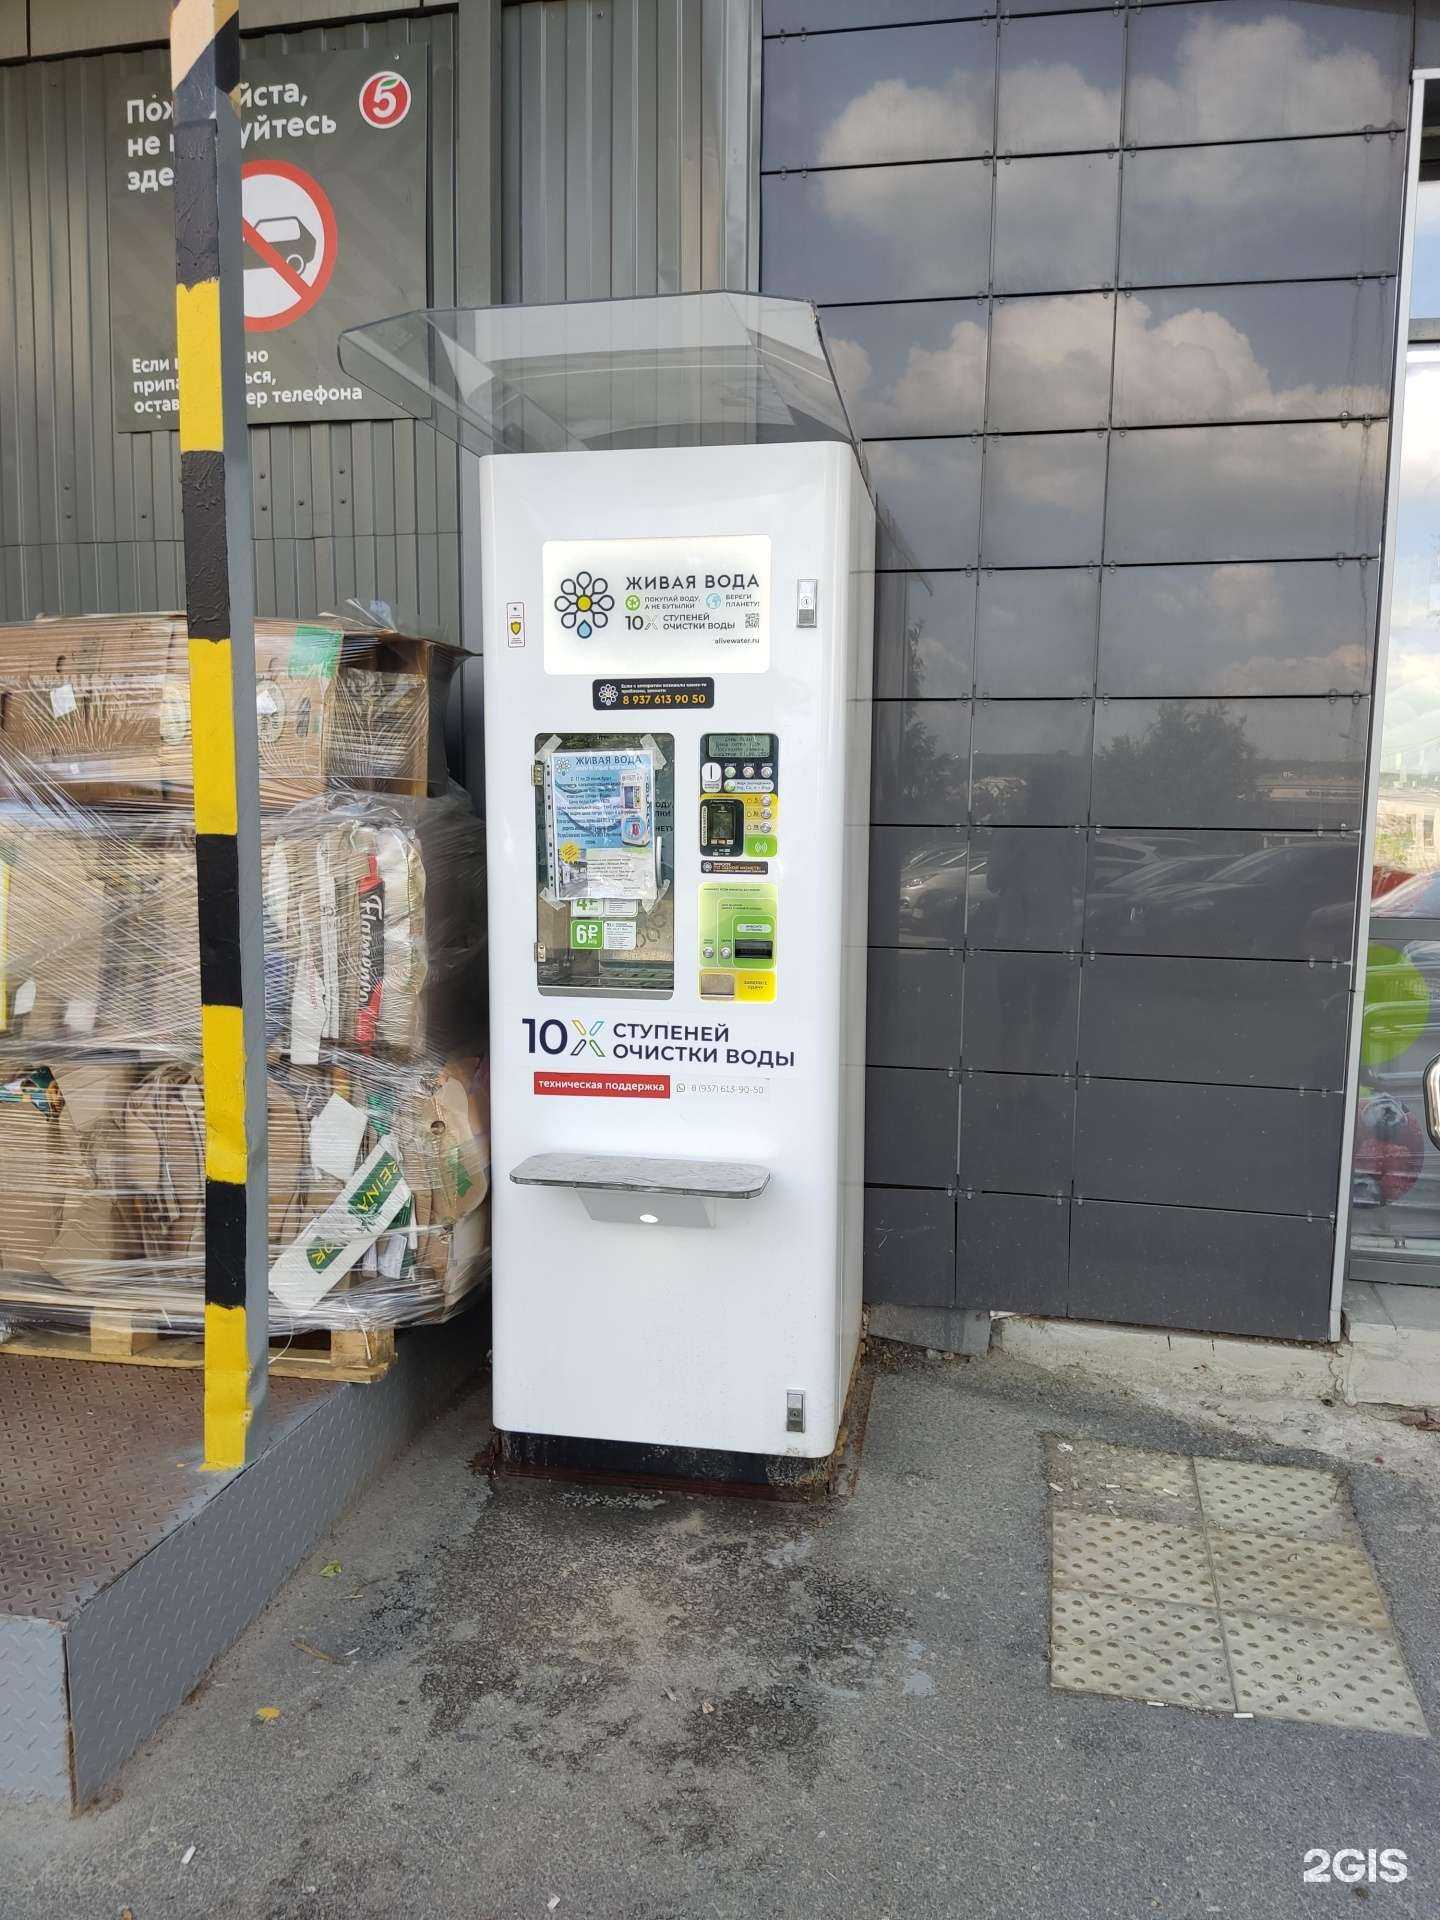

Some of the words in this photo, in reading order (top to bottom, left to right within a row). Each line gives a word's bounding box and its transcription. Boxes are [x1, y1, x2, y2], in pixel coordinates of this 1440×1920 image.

[127, 135, 161, 158] не
[127, 166, 175, 193] зде
[132, 357, 170, 374] Если
[272, 383, 363, 405] телефона
[625, 575, 697, 591] ЖИВАЯ
[705, 573, 760, 590] ВОДА
[644, 594, 678, 604] ПОКУПАЙ
[680, 595, 701, 604] ВОДУ,
[725, 593, 752, 601] БЕРЕГИ
[661, 602, 696, 610] БУТЫЛКИ
[663, 612, 710, 622] СТУПЕНЕЙ
[663, 622, 706, 631] ОЧИСТКИ
[707, 621, 736, 631] ВОДЫ
[622, 696, 629, 705] 8
[632, 696, 651, 705] 937
[654, 695, 672, 704] 613
[674, 695, 688, 704] 90
[691, 694, 706, 704] 50
[575, 755, 611, 766] ЖИВАЯ
[614, 754, 642, 766] ВОДА
[612, 1021, 730, 1043] СТУПЕНЕЙ
[612, 1043, 718, 1064] ОЧИСТКИ
[725, 1047, 796, 1069] ВОДЫ
[538, 1078, 603, 1090] техническая
[604, 1080, 665, 1094] поддержка
